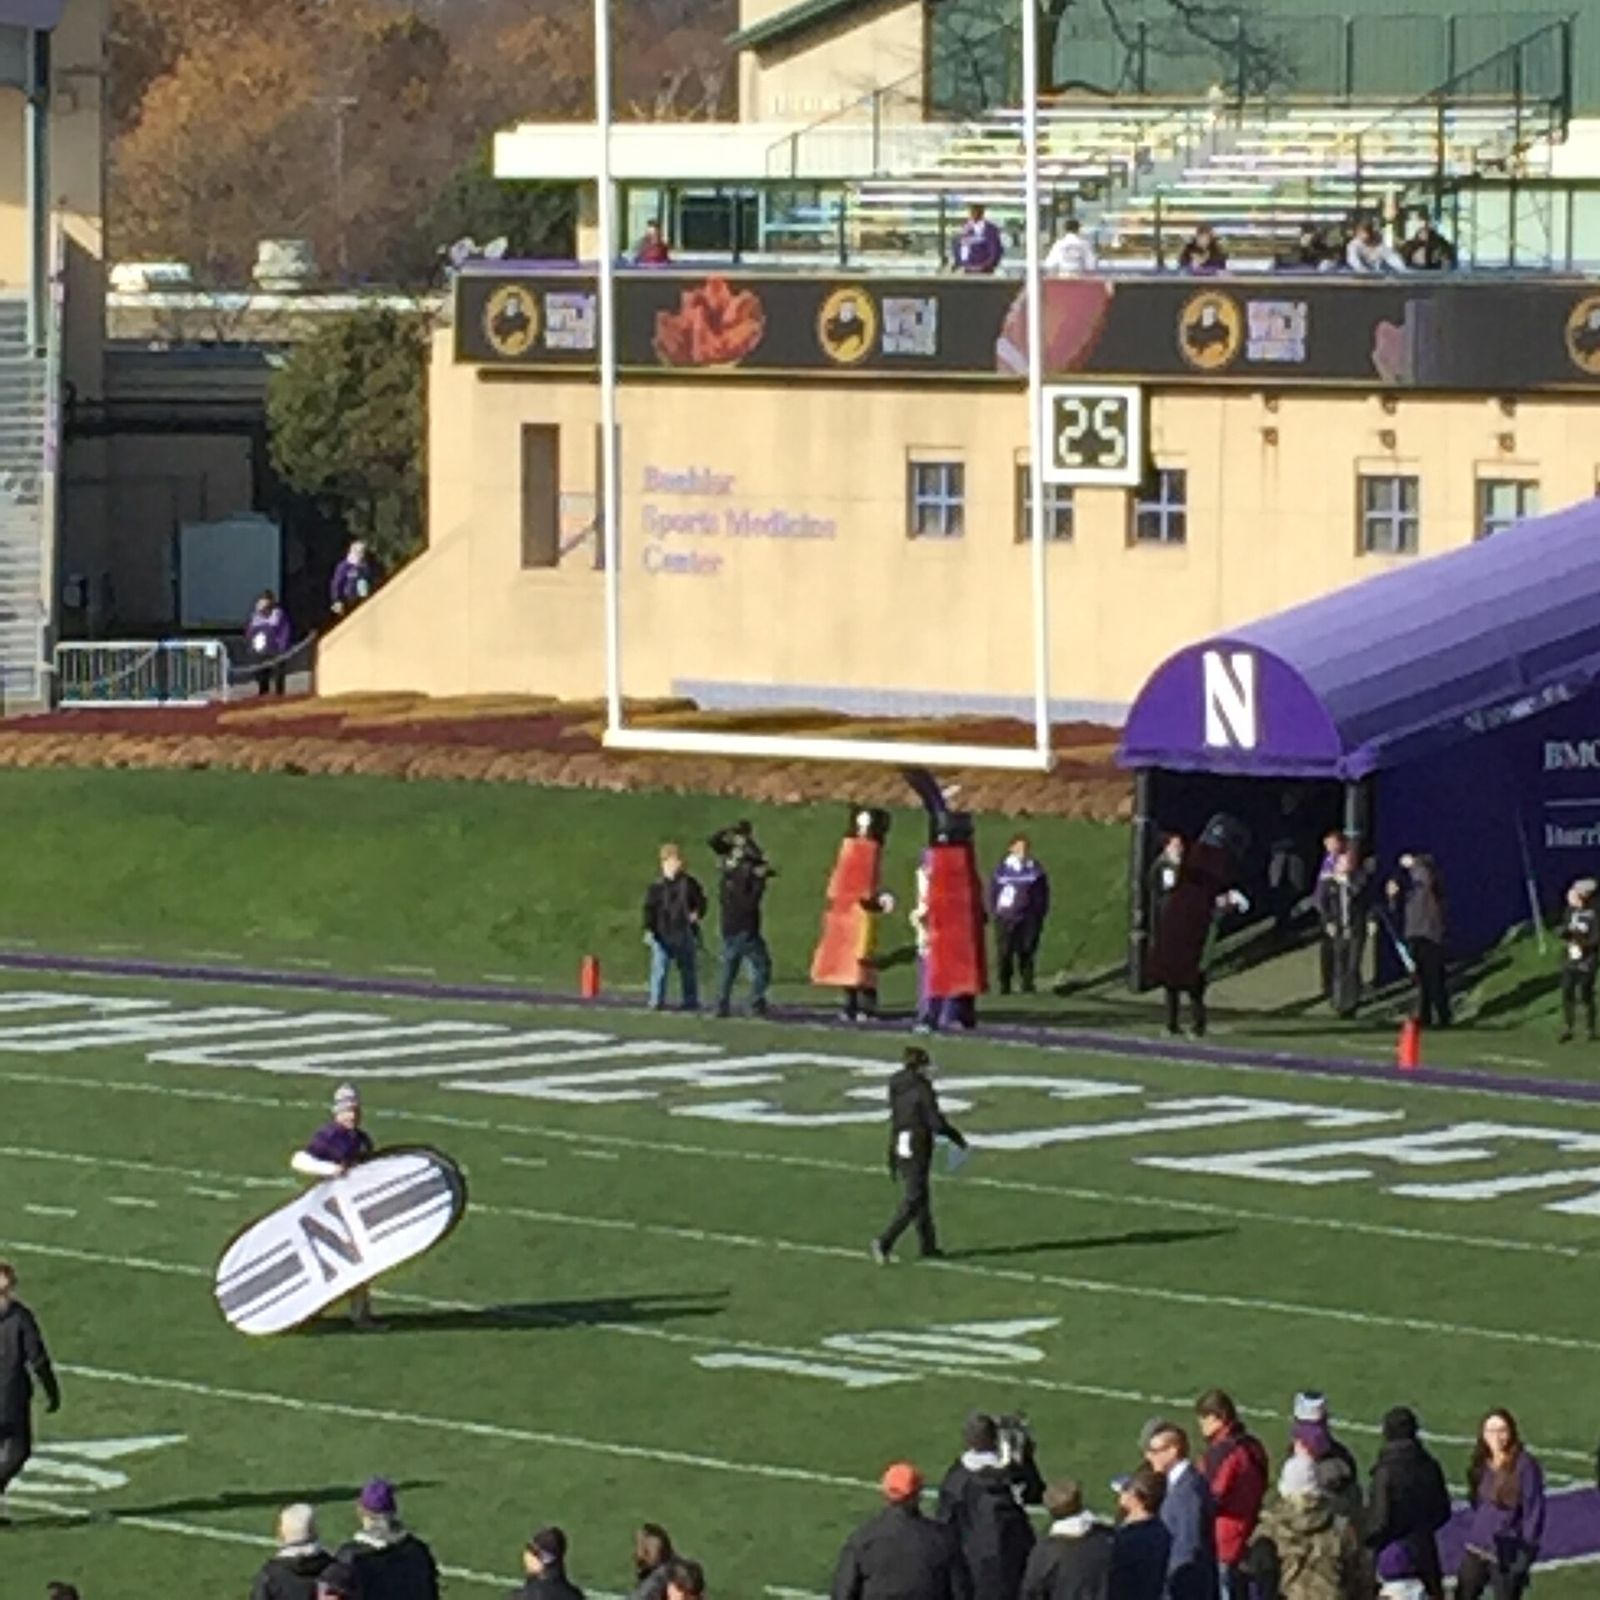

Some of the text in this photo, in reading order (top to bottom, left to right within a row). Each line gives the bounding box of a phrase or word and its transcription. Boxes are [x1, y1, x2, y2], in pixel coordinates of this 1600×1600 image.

[1059, 399, 1125, 467] 25
[643, 543, 724, 576] Center
[1203, 650, 1256, 749] N
[299, 1196, 364, 1283] N
